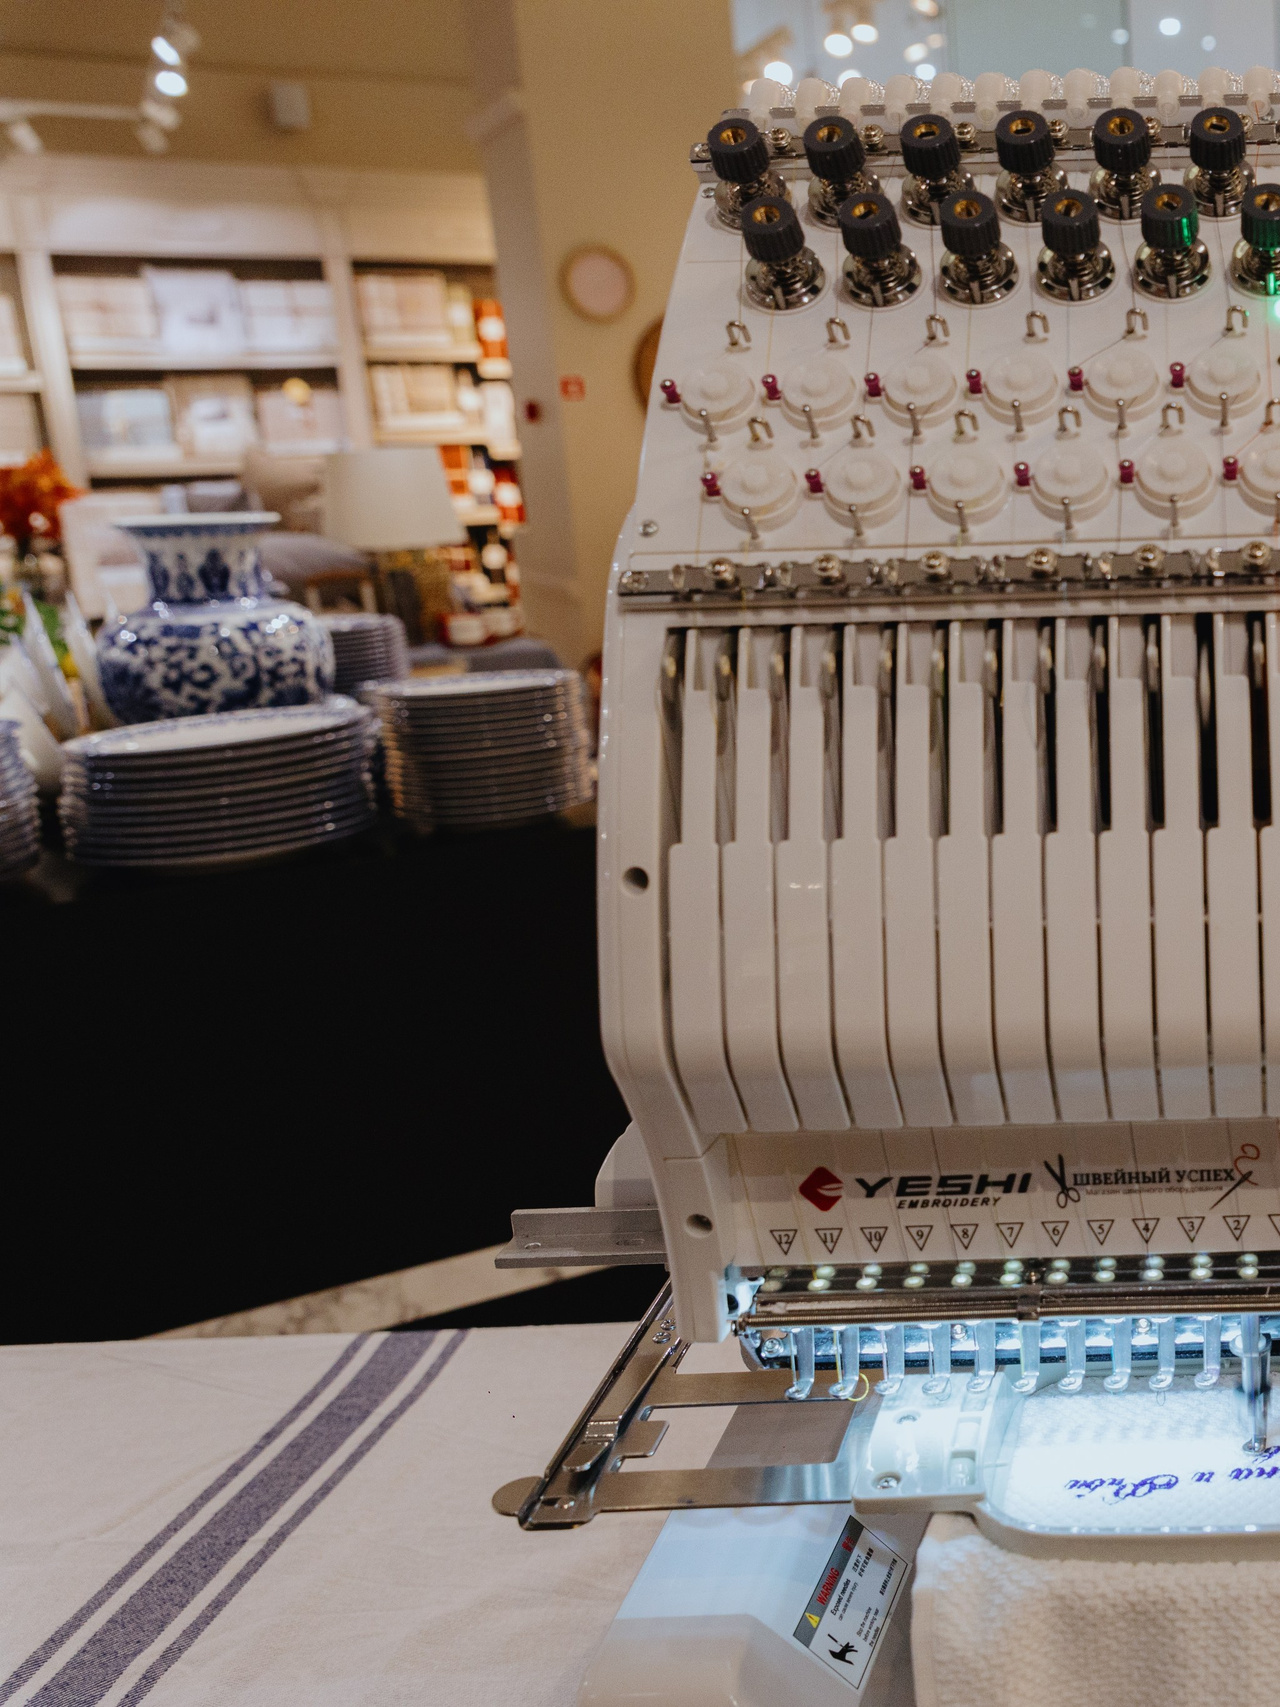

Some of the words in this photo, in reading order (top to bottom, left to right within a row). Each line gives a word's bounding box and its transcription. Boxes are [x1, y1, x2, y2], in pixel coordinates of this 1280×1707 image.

[855, 1172, 1032, 1198] YESHI
[1073, 1167, 1170, 1186] ШВЕЙНЫЙ
[1175, 1168, 1235, 1184] УСПЕХ
[897, 1196, 1001, 1209] EMBROIDERY
[1191, 1471, 1214, 1484] и
[816, 1567, 840, 1606] WARNING
[830, 1594, 844, 1616] Exposed
[839, 1578, 851, 1597] needles
